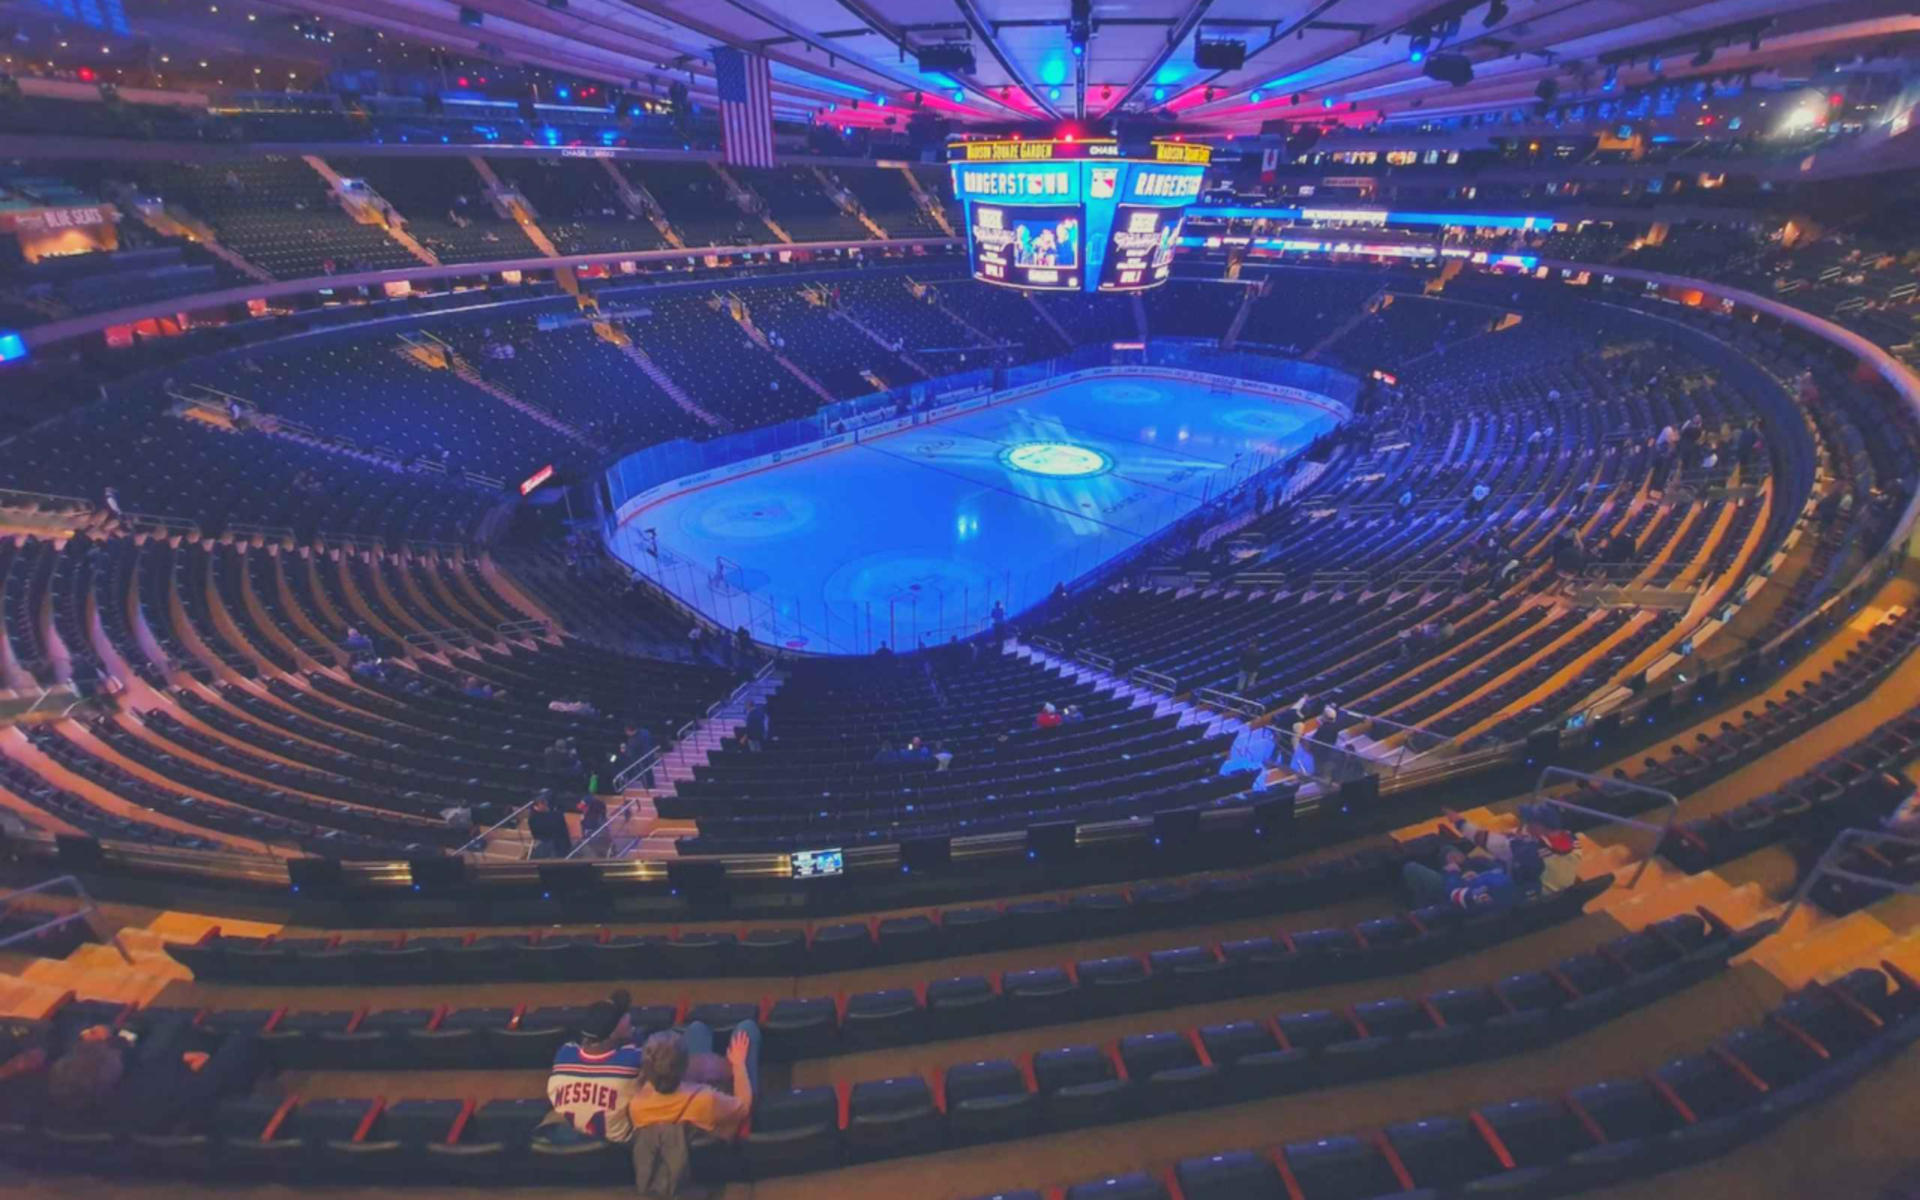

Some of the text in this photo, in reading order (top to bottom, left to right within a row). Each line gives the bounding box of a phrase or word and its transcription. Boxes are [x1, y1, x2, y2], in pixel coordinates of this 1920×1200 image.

[1089, 145, 1118, 155] CHASE
[72, 208, 102, 225] SEATS
[554, 1082, 618, 1111] MESSIER
